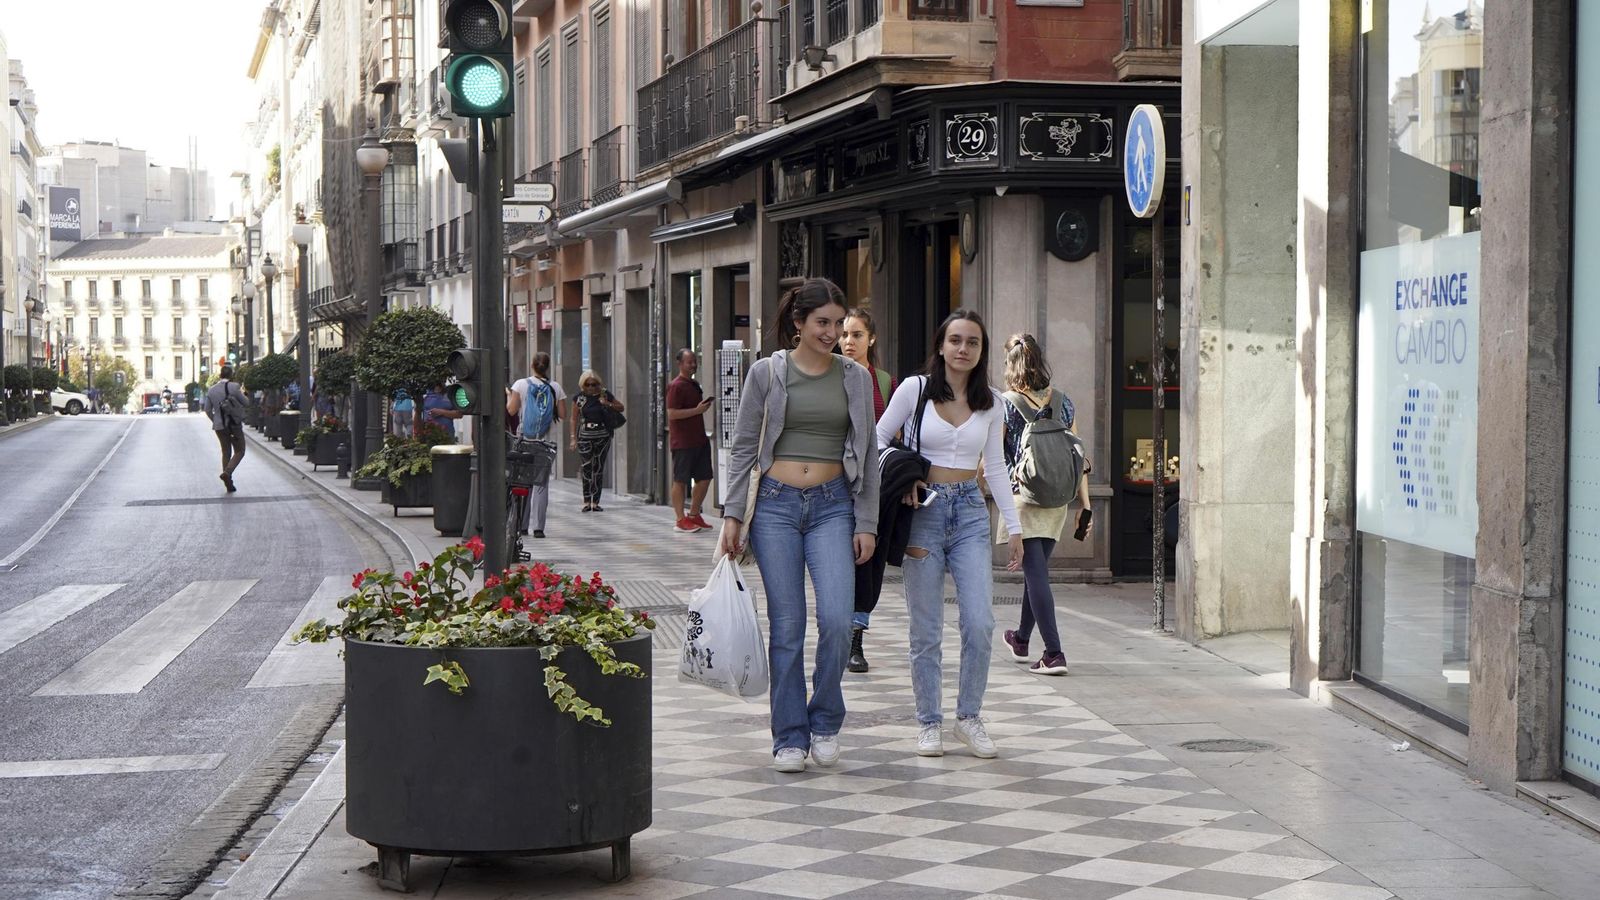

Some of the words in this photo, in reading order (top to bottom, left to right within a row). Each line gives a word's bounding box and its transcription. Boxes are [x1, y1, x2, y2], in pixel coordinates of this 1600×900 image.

[961, 126, 984, 150] 29
[50, 213, 72, 223] MARCA
[72, 214, 80, 223] LA
[50, 221, 80, 230] DIFERENCIA
[1396, 272, 1468, 310] EXCHANGE
[1396, 318, 1467, 365] CAMBIO
